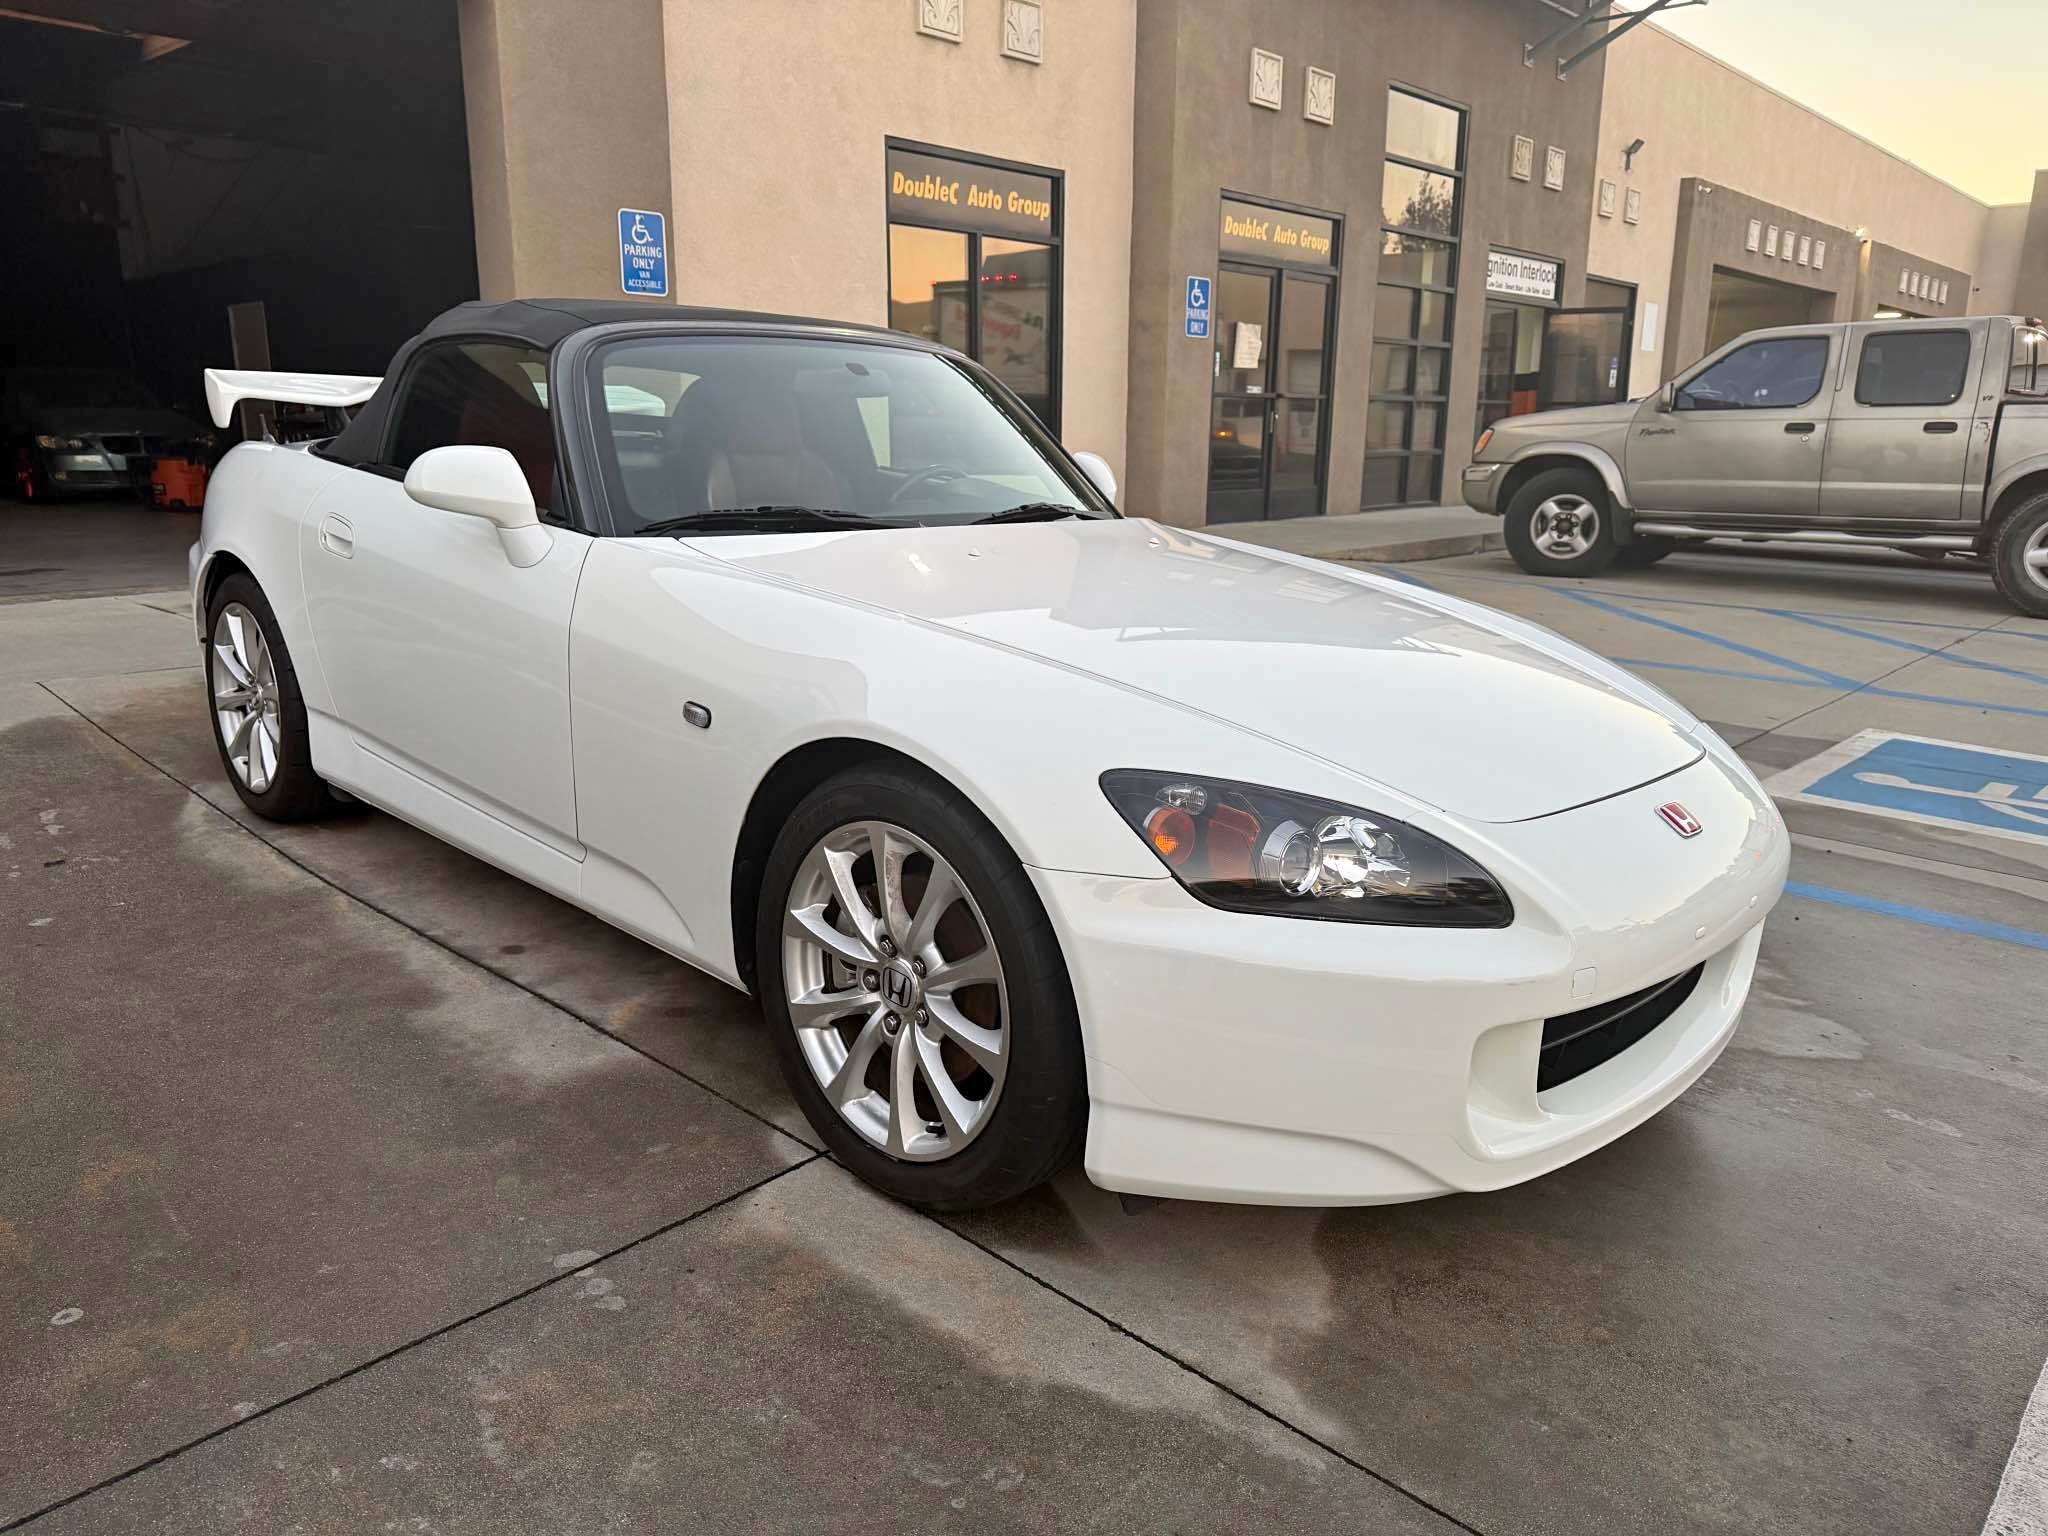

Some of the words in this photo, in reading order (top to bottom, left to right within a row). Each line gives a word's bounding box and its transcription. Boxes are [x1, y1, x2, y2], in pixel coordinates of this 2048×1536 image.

[893, 171, 960, 204] DoubleC
[968, 185, 1002, 210] Auto
[1008, 191, 1051, 221] Group
[1224, 215, 1269, 241] DoubleC
[1274, 225, 1297, 246] Auto
[1300, 230, 1330, 254] Group
[624, 243, 662, 258] PARKING
[632, 258, 655, 270] ONLY
[1487, 256, 1518, 278] gnition
[1520, 260, 1557, 283] Interlock
[639, 270, 650, 279] VAN
[628, 279, 662, 289] ACCESSIBLE
[1190, 321, 1204, 334] ONLY
